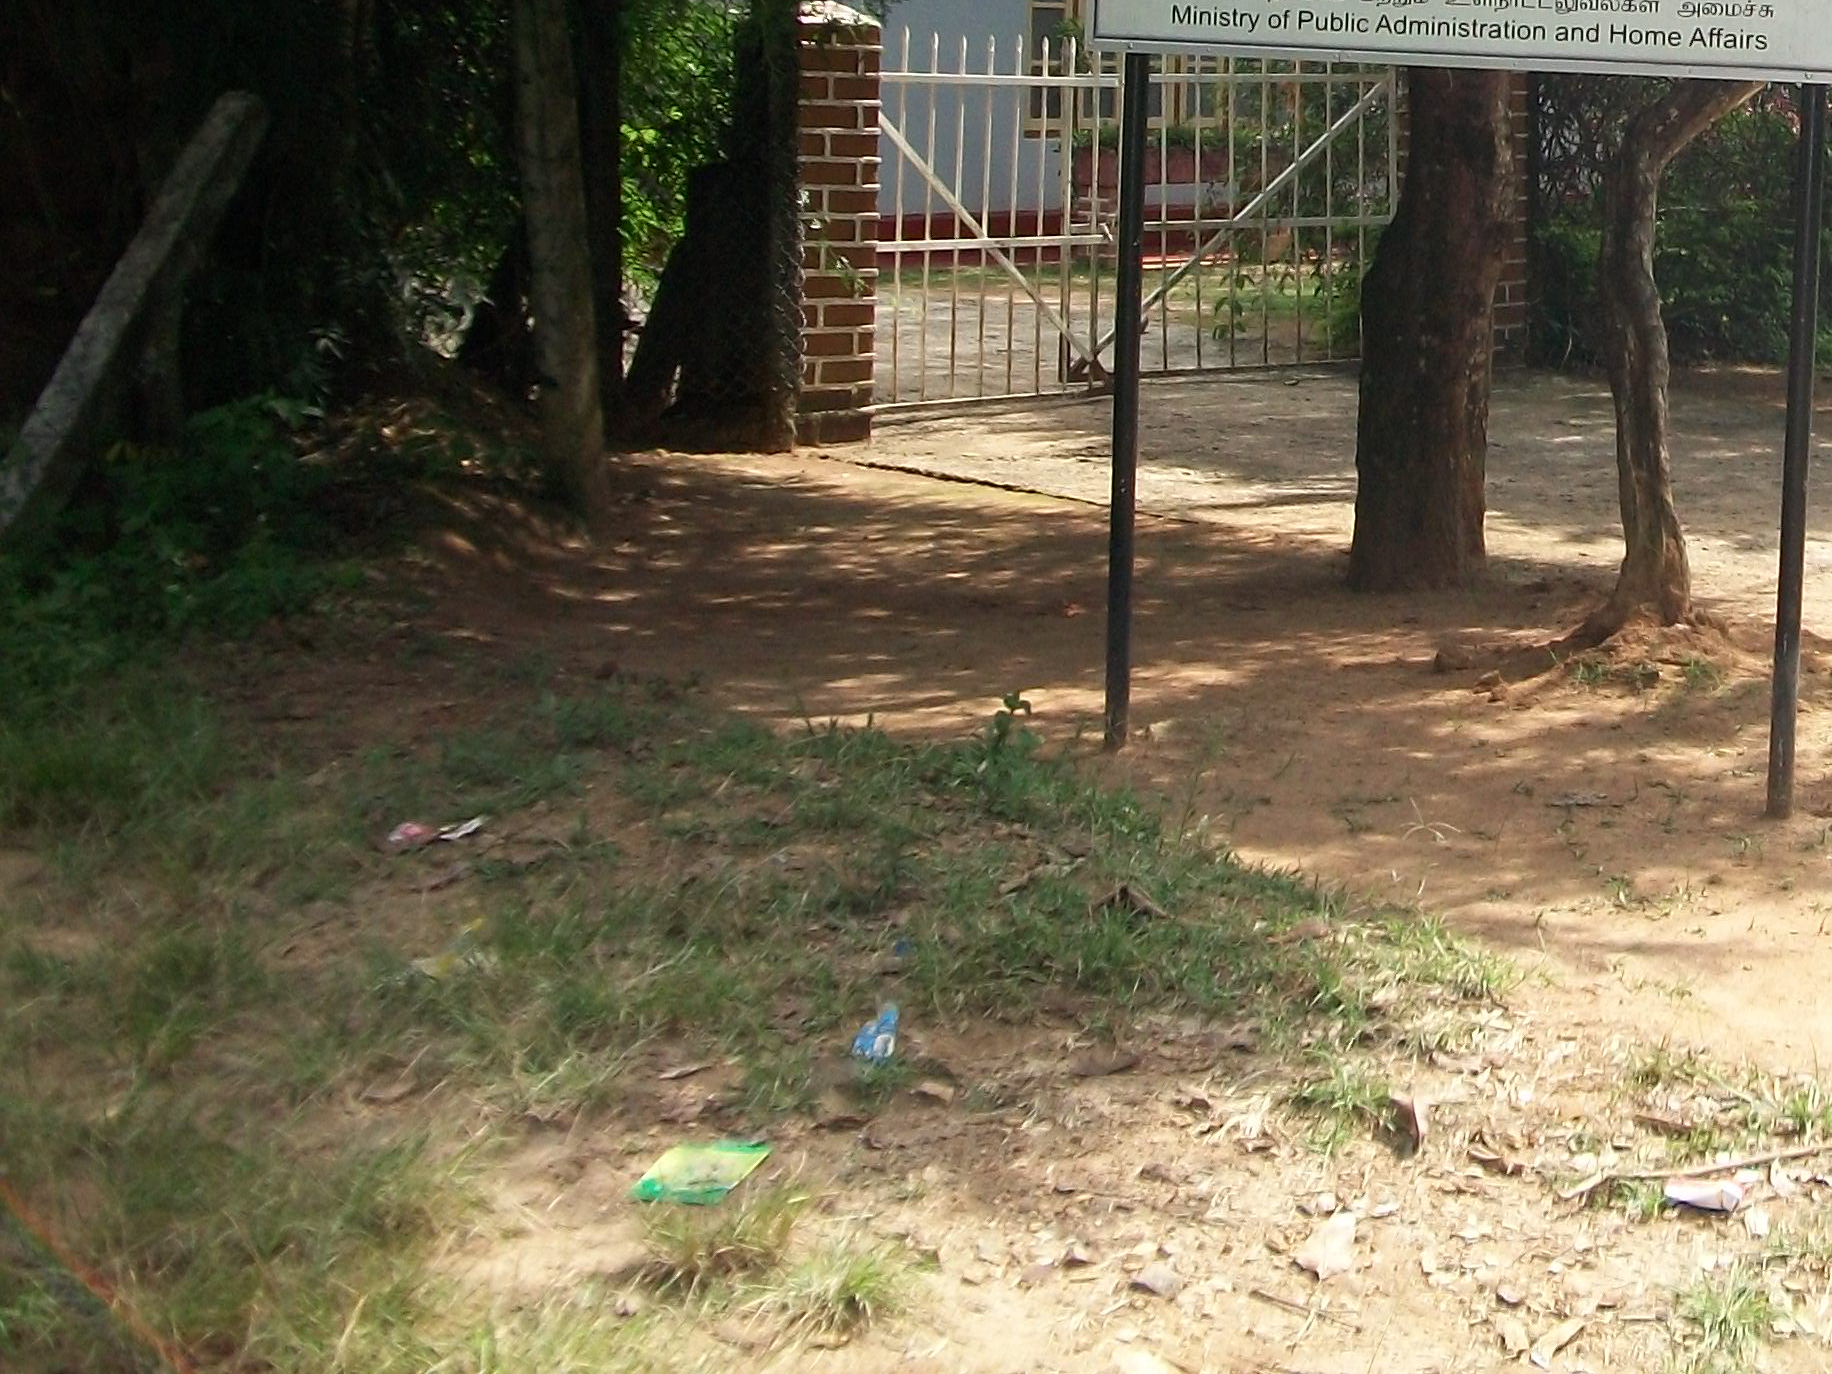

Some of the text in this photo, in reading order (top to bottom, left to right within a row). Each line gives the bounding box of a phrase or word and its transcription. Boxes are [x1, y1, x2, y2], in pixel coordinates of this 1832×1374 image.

[1677, 0, 1775, 19] அமைச்சு
[1172, 4, 1768, 51] Ministry of Public Administration and Home Affairs
